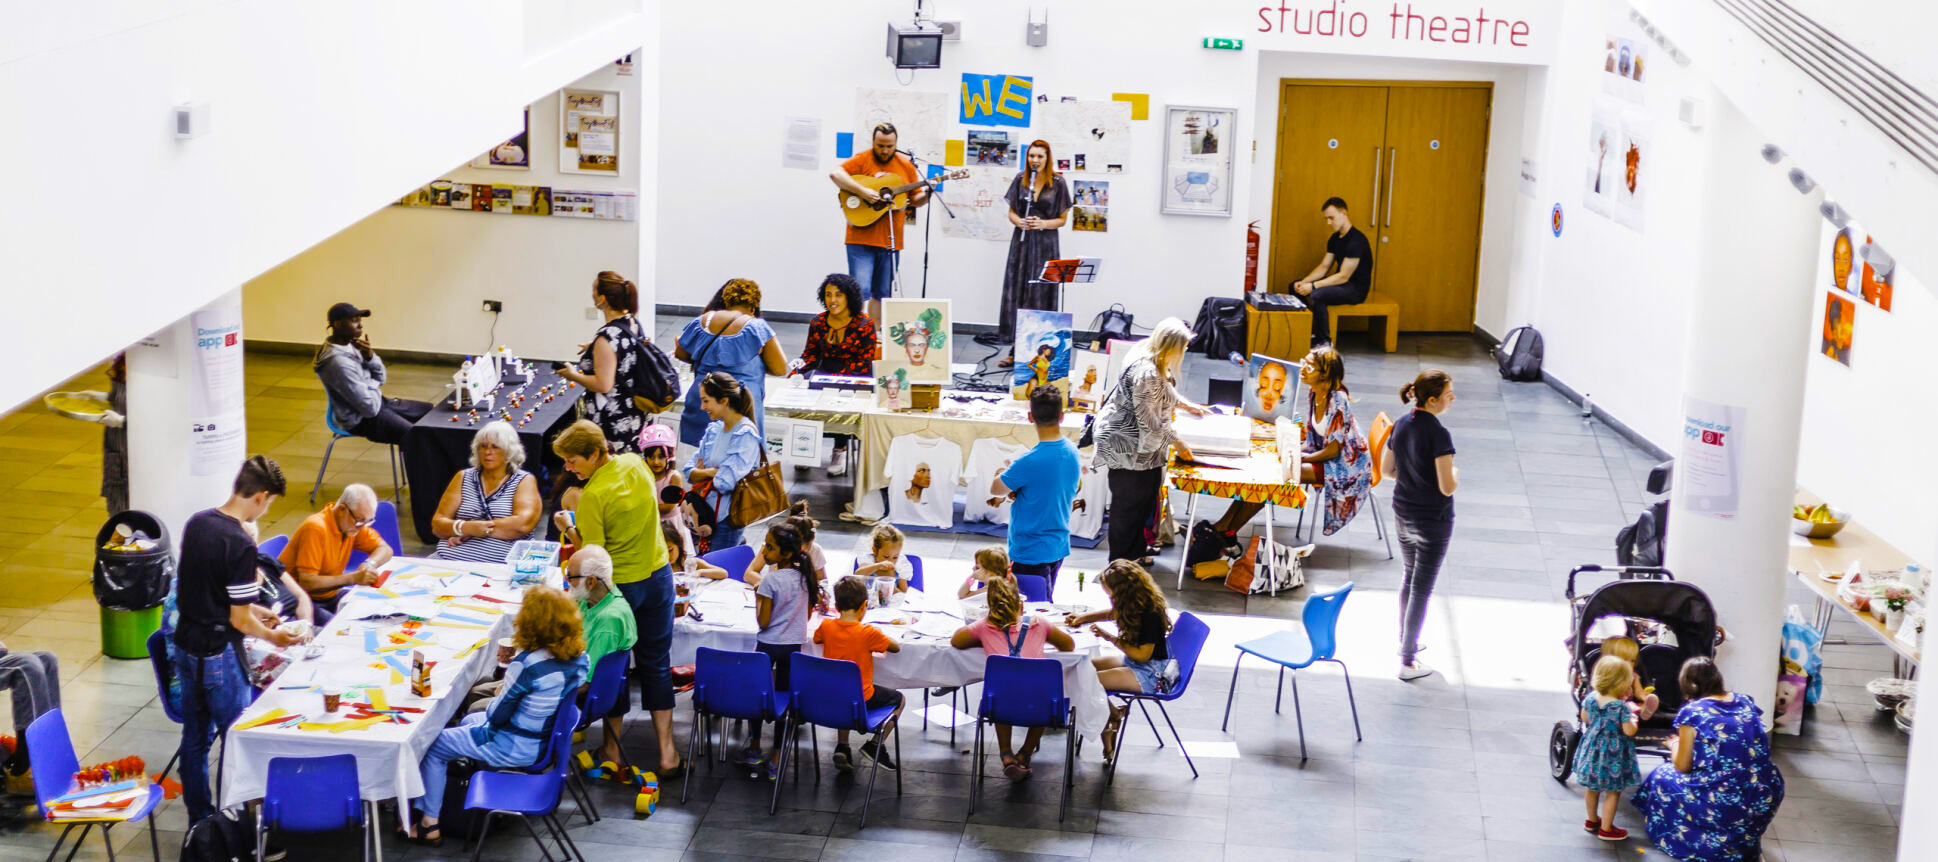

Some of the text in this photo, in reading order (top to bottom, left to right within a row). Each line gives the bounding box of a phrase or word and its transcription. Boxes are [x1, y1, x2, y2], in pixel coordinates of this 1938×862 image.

[1258, 0, 1530, 47] studio theatre
[962, 75, 1032, 119] WE
[198, 337, 223, 349] app
[1684, 425, 1700, 440] pp
